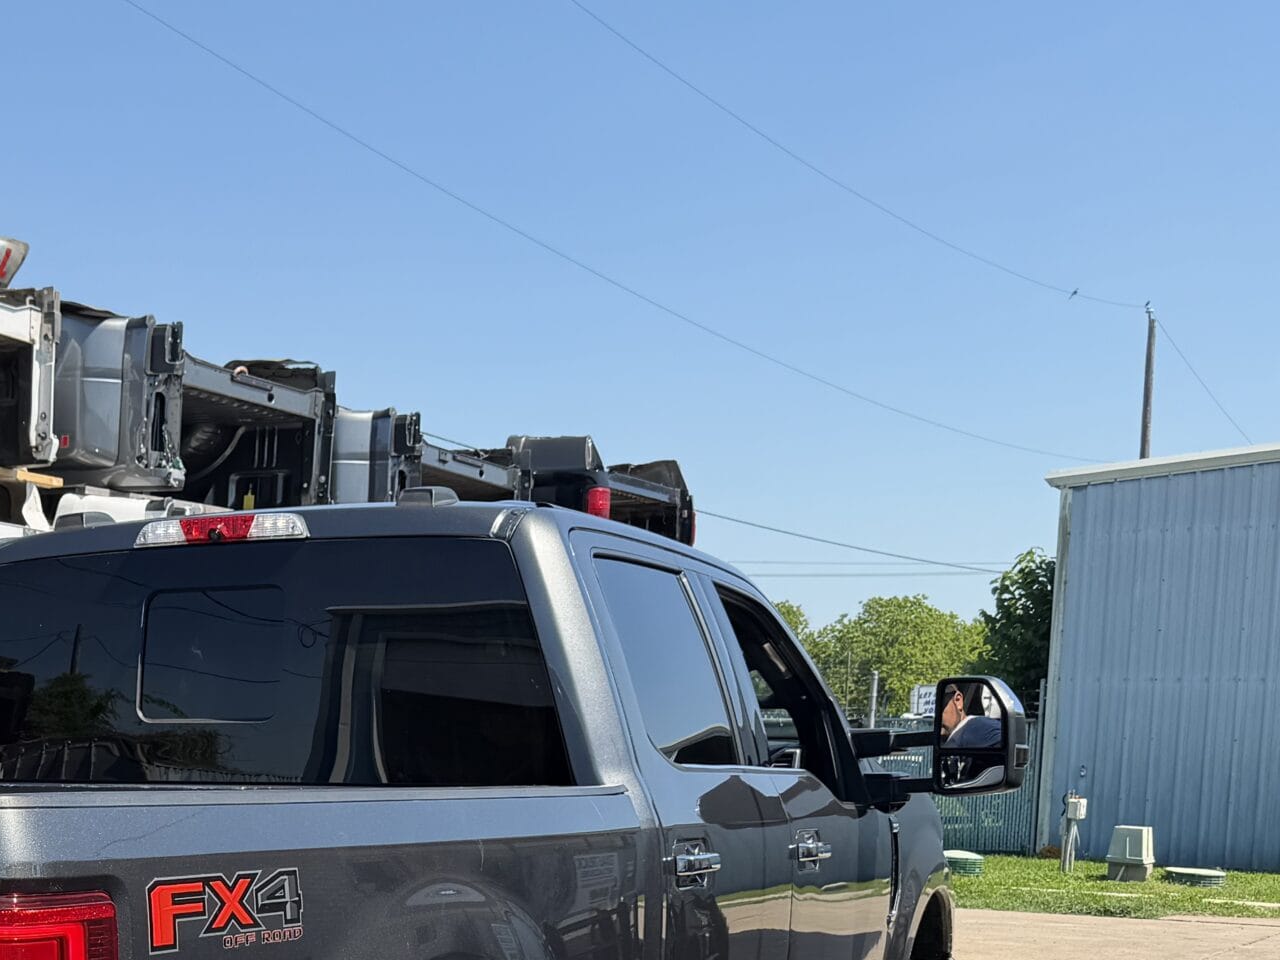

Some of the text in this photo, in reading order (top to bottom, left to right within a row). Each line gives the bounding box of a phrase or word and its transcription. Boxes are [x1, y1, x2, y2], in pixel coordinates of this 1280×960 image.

[145, 867, 304, 955] FX4
[222, 927, 304, 949] OFF ROAD
